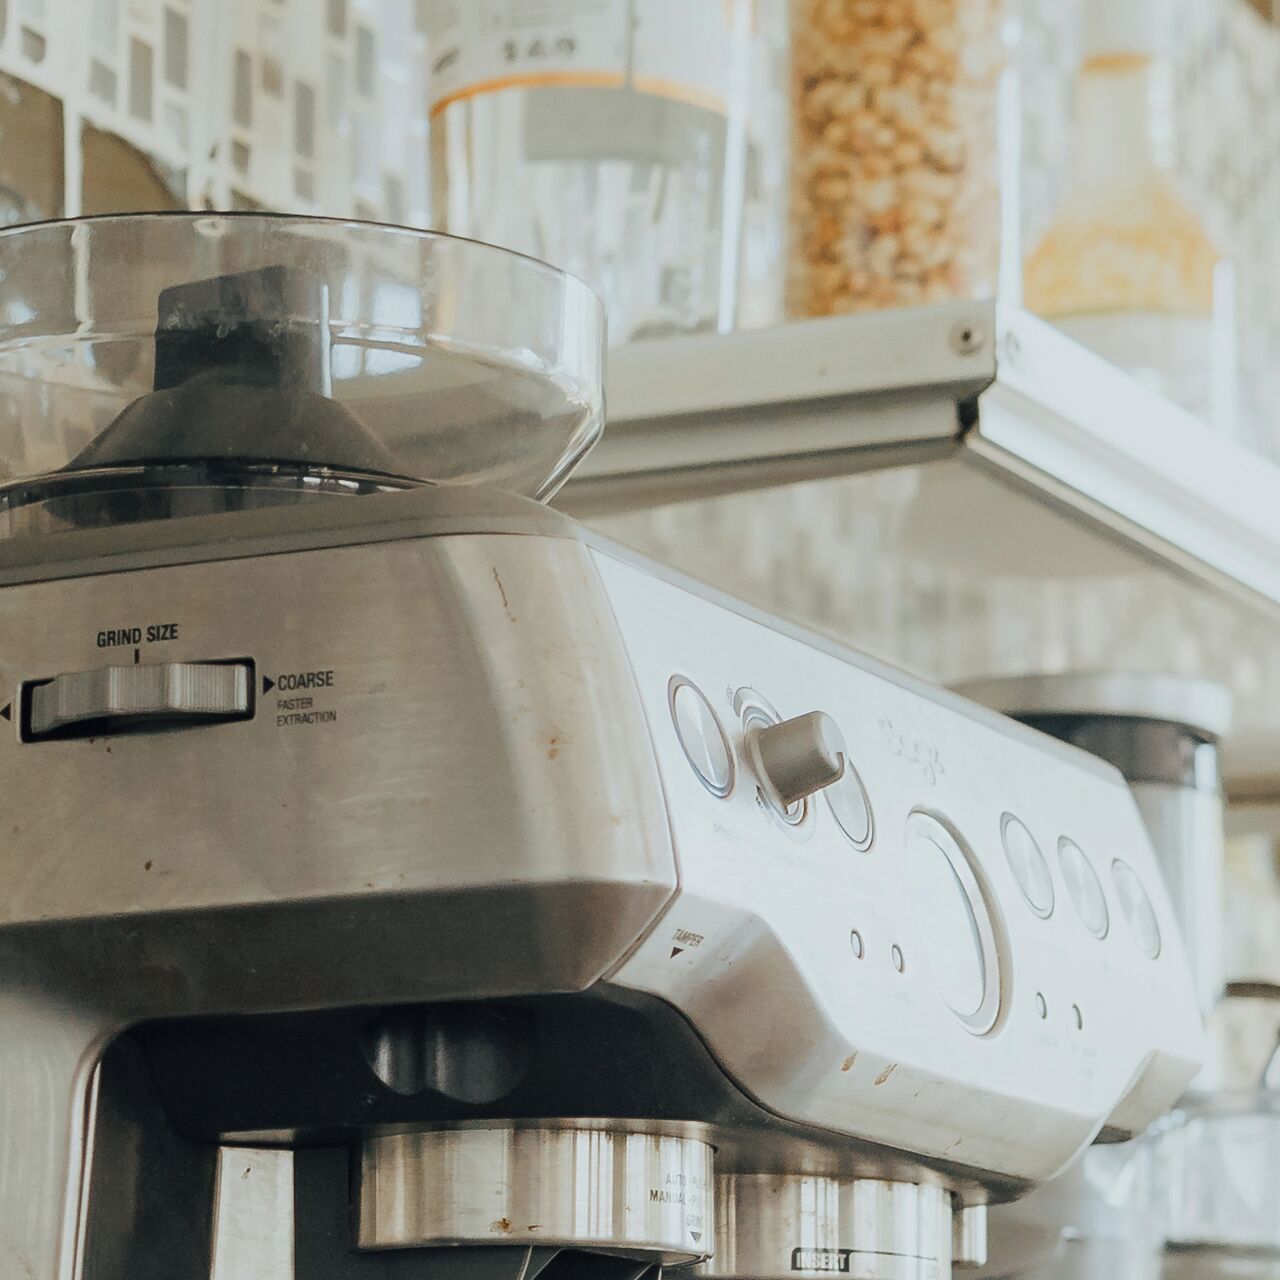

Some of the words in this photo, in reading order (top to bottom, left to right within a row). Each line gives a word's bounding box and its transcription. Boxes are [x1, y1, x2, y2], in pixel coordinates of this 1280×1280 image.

[97, 628, 142, 648] GRIND
[146, 623, 179, 642] SIZE
[277, 670, 334, 691] COARSE
[277, 697, 313, 711] FASTER
[276, 710, 337, 727] EXTRACTION
[672, 928, 704, 948] TAMPER
[796, 1249, 849, 1272] INSERT
